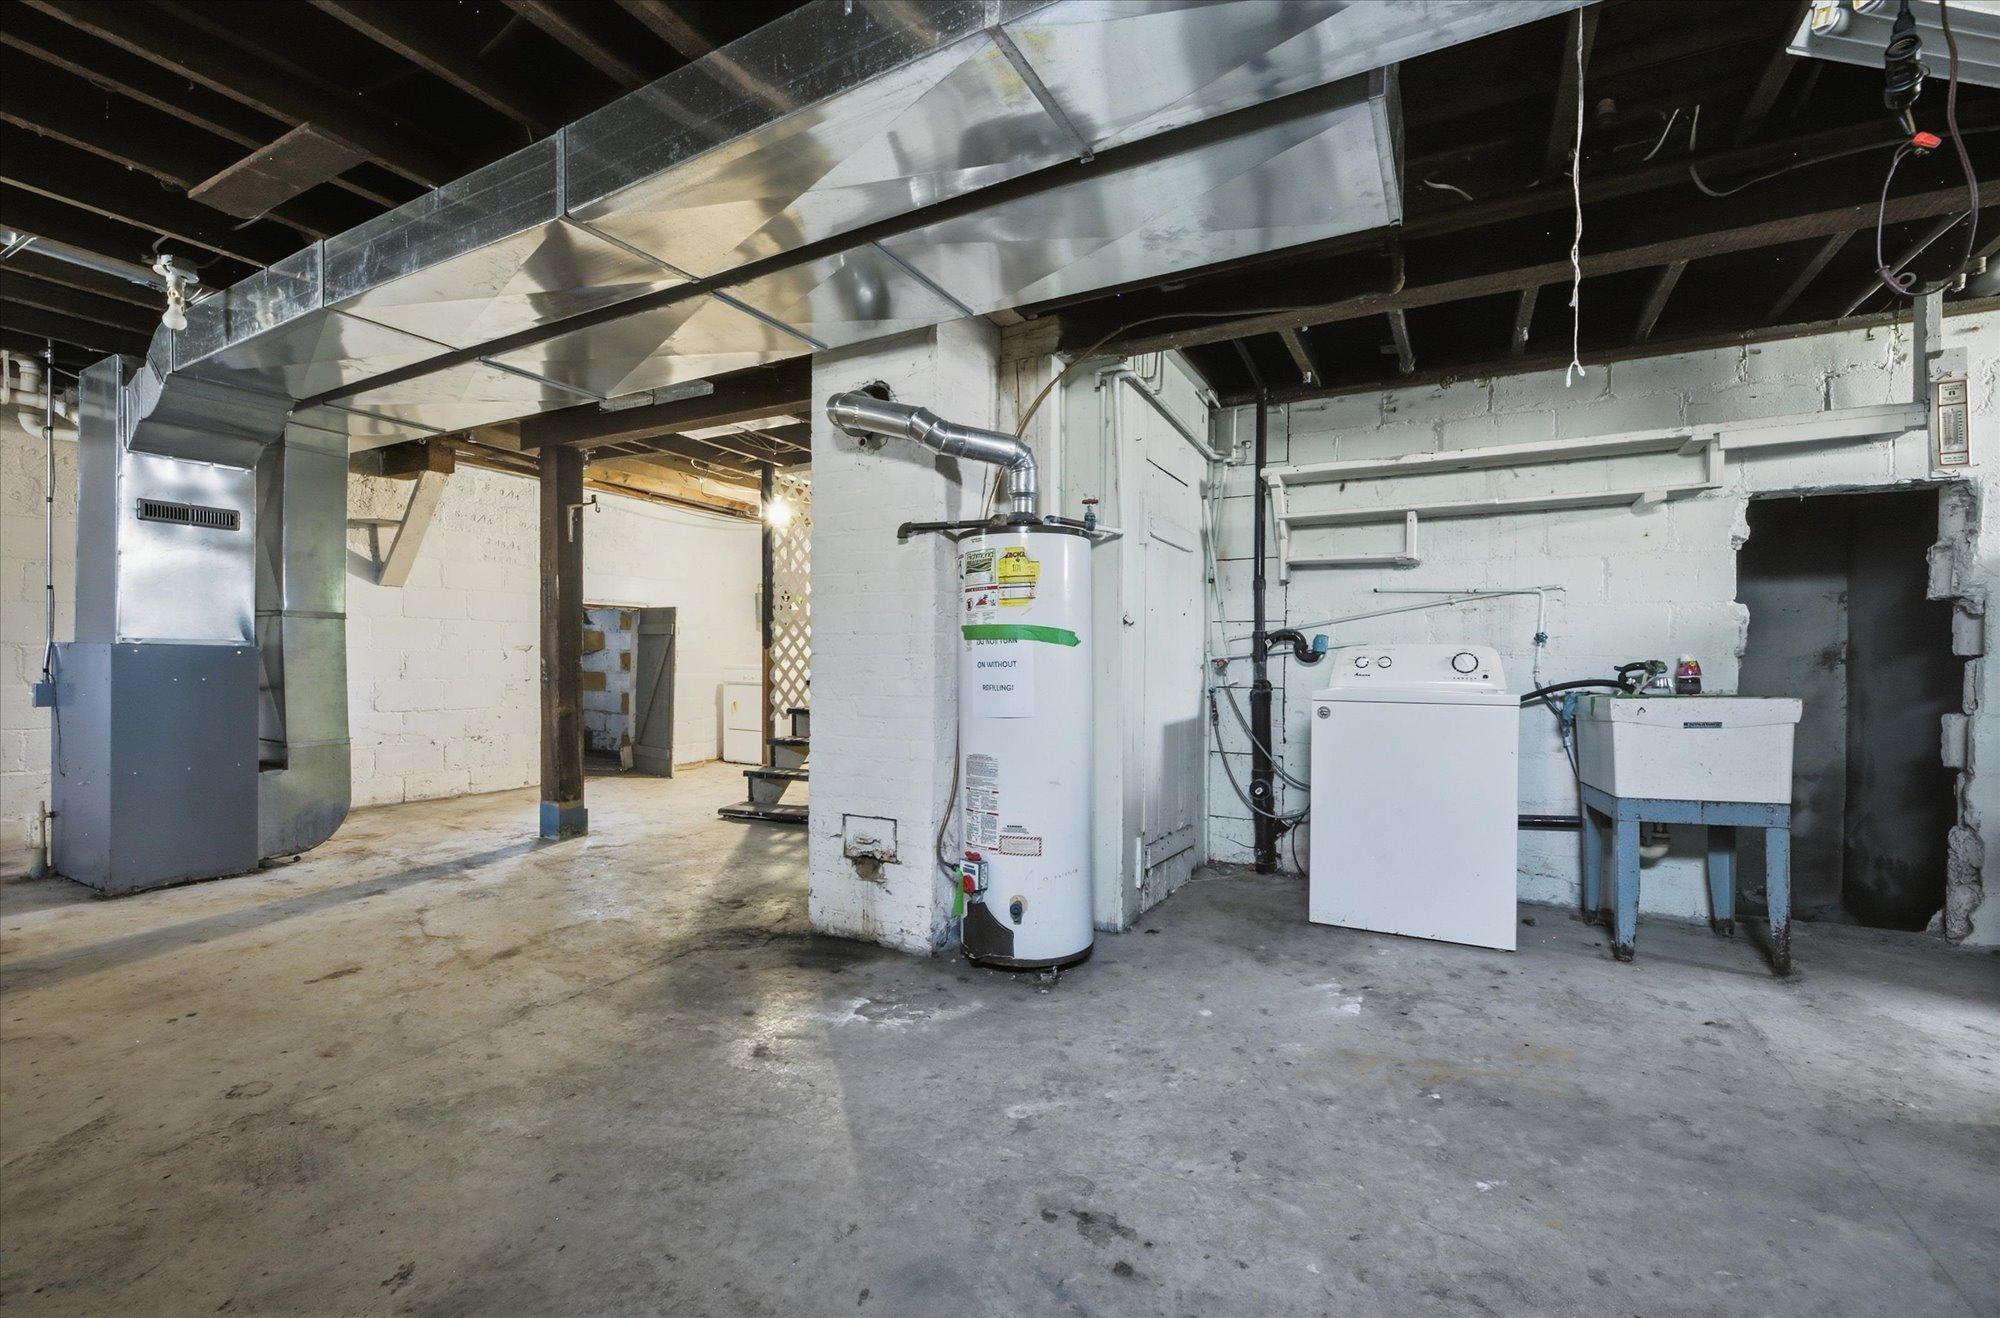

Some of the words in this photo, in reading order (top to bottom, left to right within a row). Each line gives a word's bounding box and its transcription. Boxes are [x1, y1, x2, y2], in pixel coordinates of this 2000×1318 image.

[977, 661, 986, 669] ON
[987, 660, 1017, 668] WITHOUT
[982, 684, 1014, 692] REFILLING!
